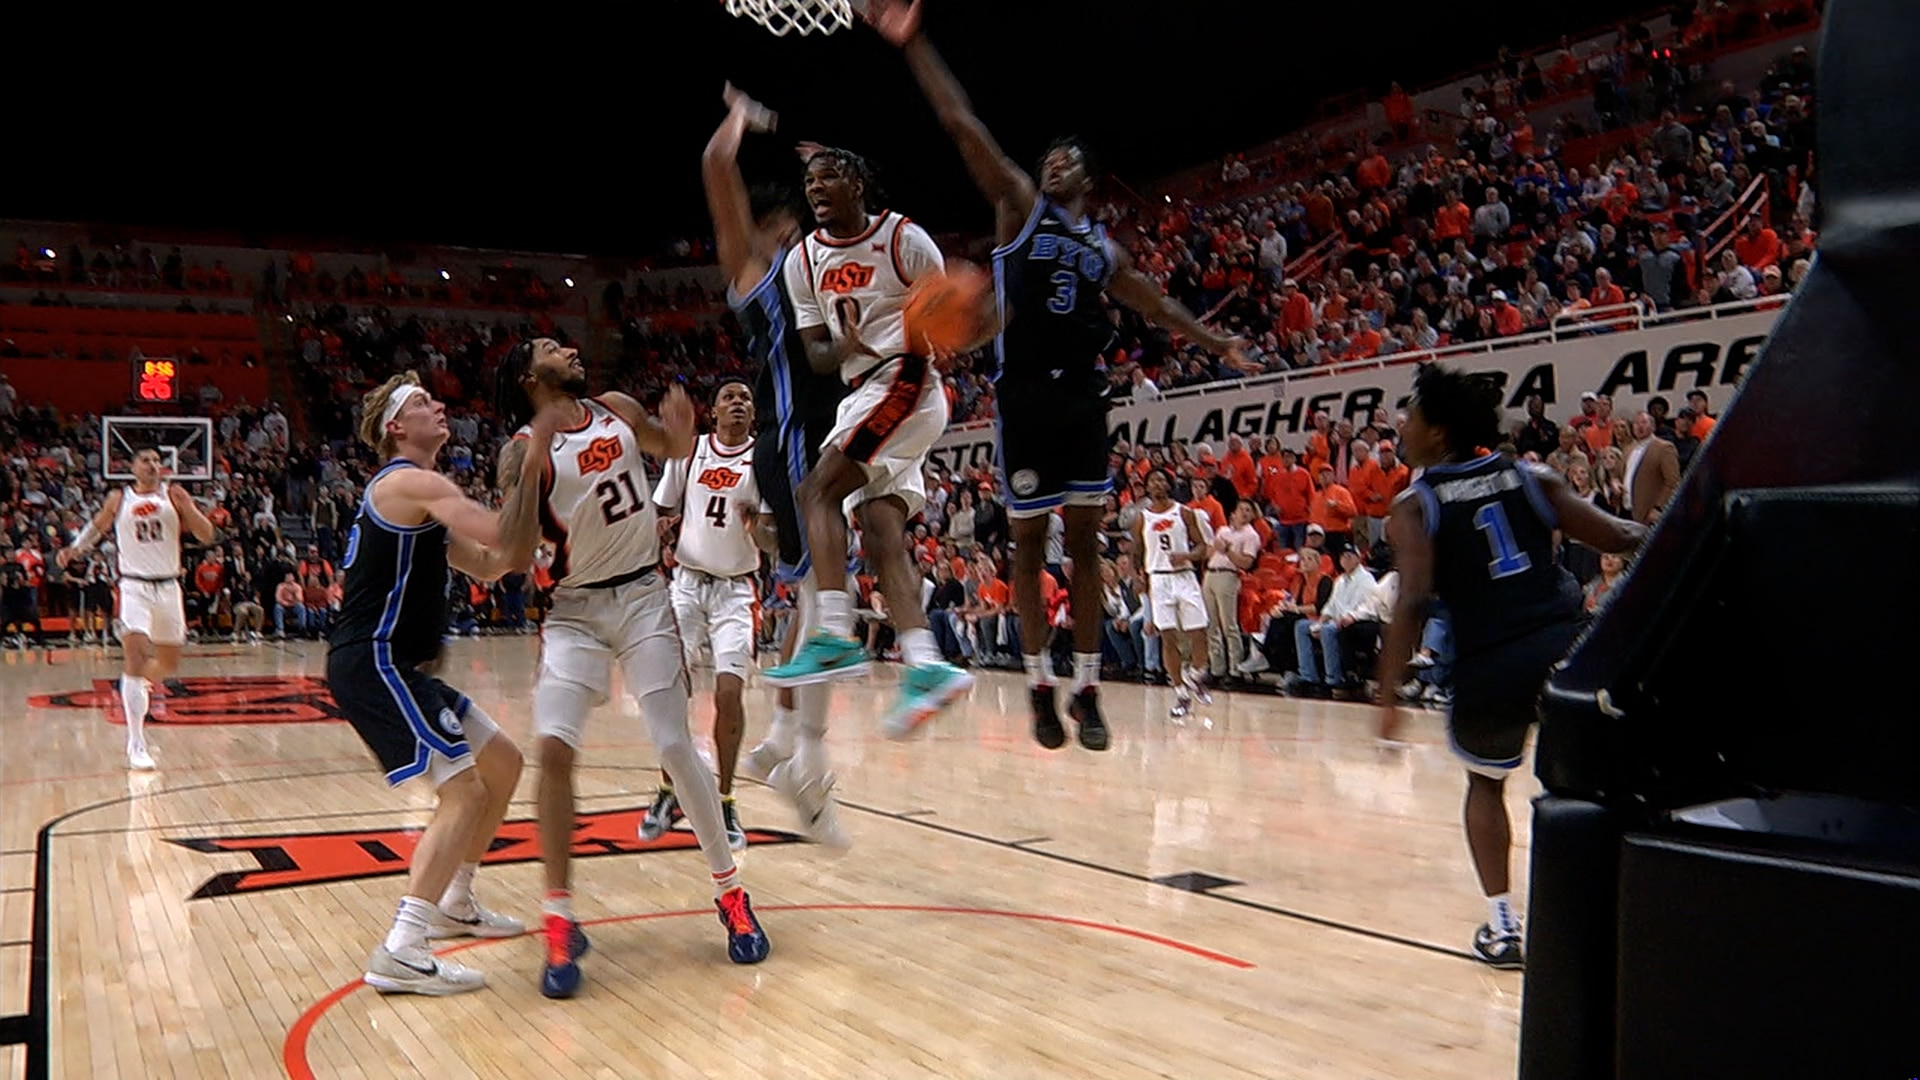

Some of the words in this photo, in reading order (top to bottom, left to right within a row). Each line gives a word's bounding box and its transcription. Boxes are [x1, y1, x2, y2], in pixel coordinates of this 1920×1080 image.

[820, 262, 875, 294] OSU
[1027, 233, 1105, 282] BYU
[1046, 270, 1077, 314] 3
[1598, 334, 1768, 397] ARE
[578, 435, 623, 477] OSU
[596, 470, 645, 527] 21
[697, 466, 743, 490] OSU
[705, 495, 727, 528] 4
[1159, 534, 1171, 551] 9
[1472, 500, 1532, 580] 1
